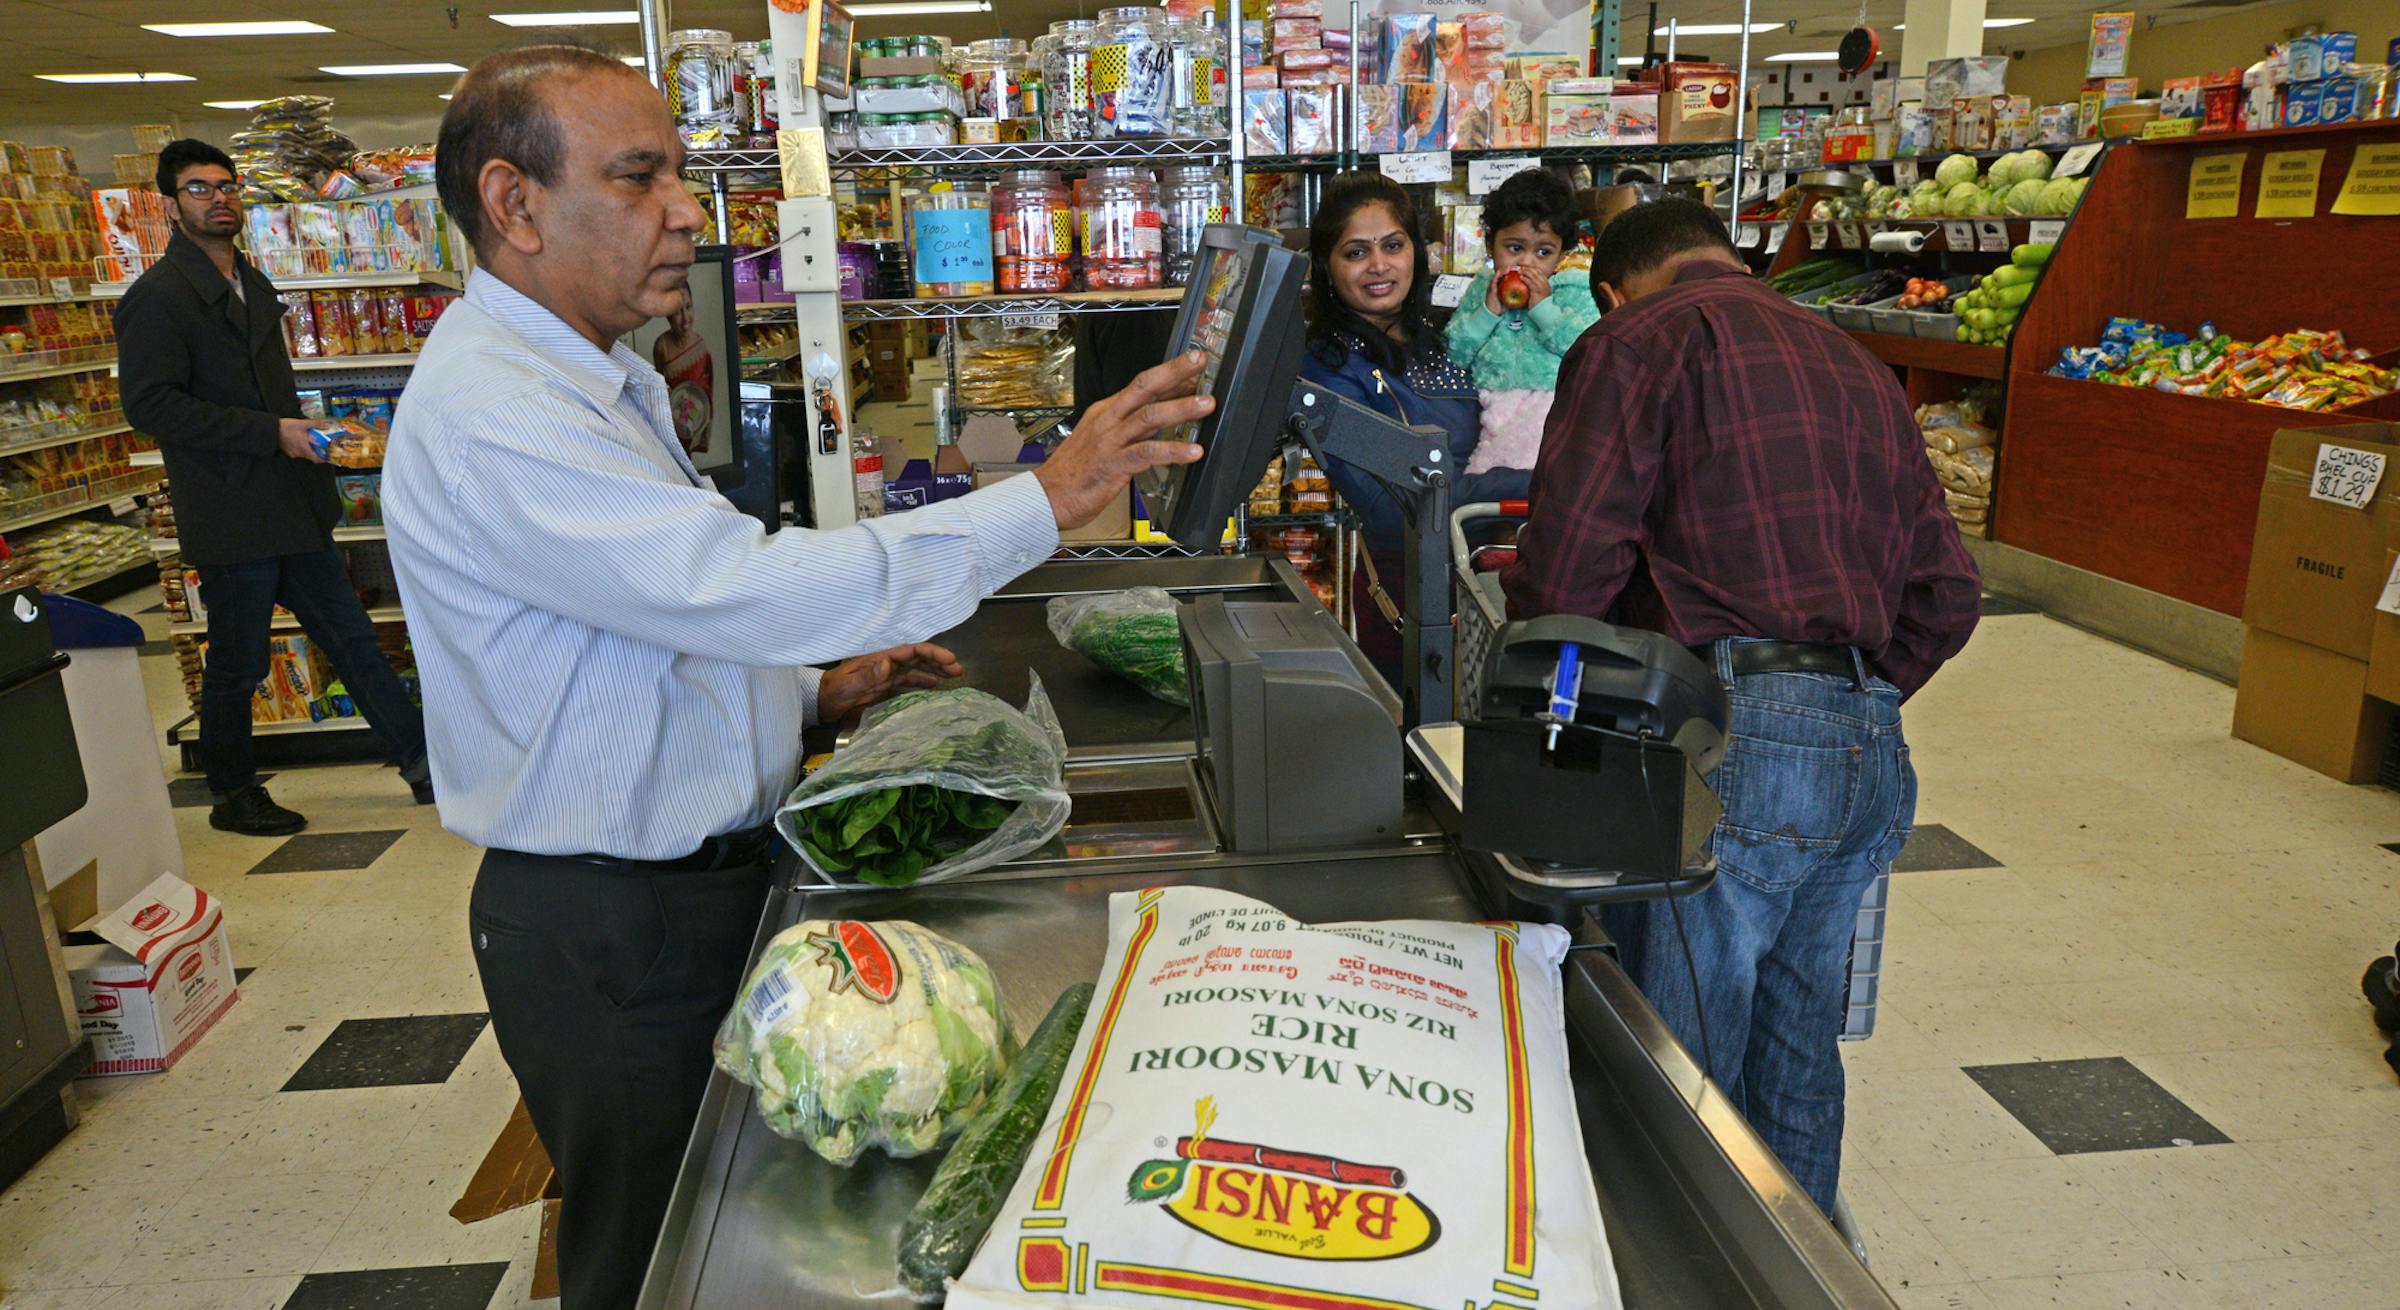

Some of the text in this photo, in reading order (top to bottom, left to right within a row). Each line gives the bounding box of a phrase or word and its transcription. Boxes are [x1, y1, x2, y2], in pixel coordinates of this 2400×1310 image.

[922, 224, 949, 234] FOOD
[934, 240, 971, 252] COLOR
[1033, 315, 1056, 325] EACH
[2319, 460, 2377, 484] BHEL CUP
[2316, 475, 2365, 503] $1.29
[2296, 556, 2345, 580] FRAGILE
[1188, 909, 1225, 928] L'INDE
[1230, 908, 1248, 916] DE
[1195, 924, 1212, 941] 20
[1225, 919, 1246, 932] Kg
[1250, 919, 1286, 932] 9.07
[1178, 935, 1192, 947] lb
[1389, 932, 1455, 950] PRODUCT
[1400, 943, 1428, 958] WT.
[1433, 952, 1463, 970] NET
[1162, 984, 1457, 1040] RIZ SONA MASOORI
[1250, 1012, 1359, 1051] RICE
[1128, 1046, 1474, 1114] SONA MASOORI
[1192, 1164, 1399, 1241] BANSI
[1254, 1228, 1326, 1250] Best VALUE
